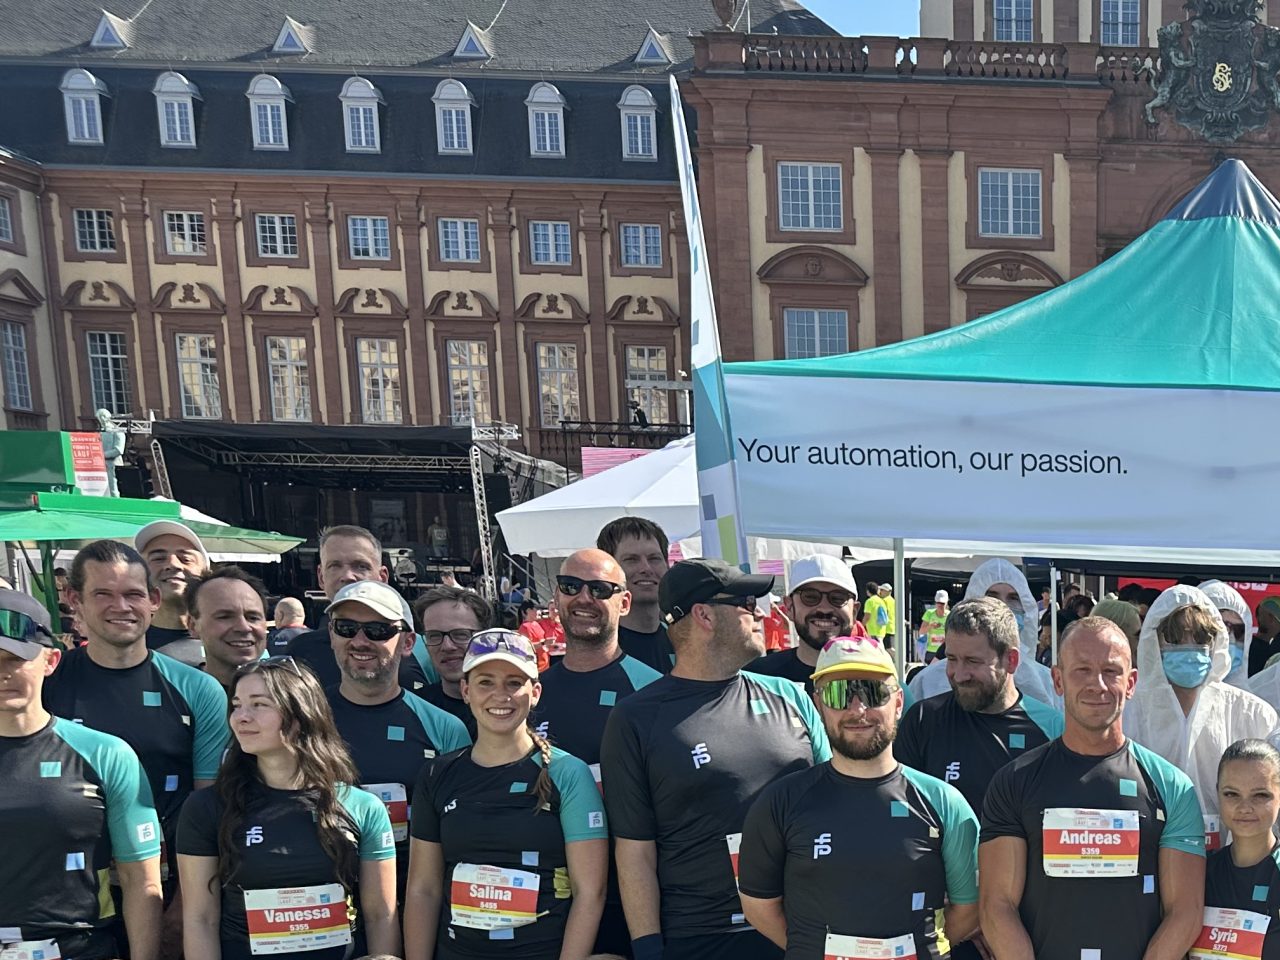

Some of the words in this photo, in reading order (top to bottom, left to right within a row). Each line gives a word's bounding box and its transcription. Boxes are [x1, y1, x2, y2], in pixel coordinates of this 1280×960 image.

[739, 438, 800, 464] Your
[808, 443, 963, 472] automation,
[969, 451, 1014, 471] our
[1020, 450, 1129, 477] passion.
[1059, 830, 1122, 845] Andreas
[1081, 847, 1100, 855] 5359
[469, 884, 512, 901] Salina
[264, 907, 331, 923] Vanessa
[1209, 927, 1238, 944] Syria
